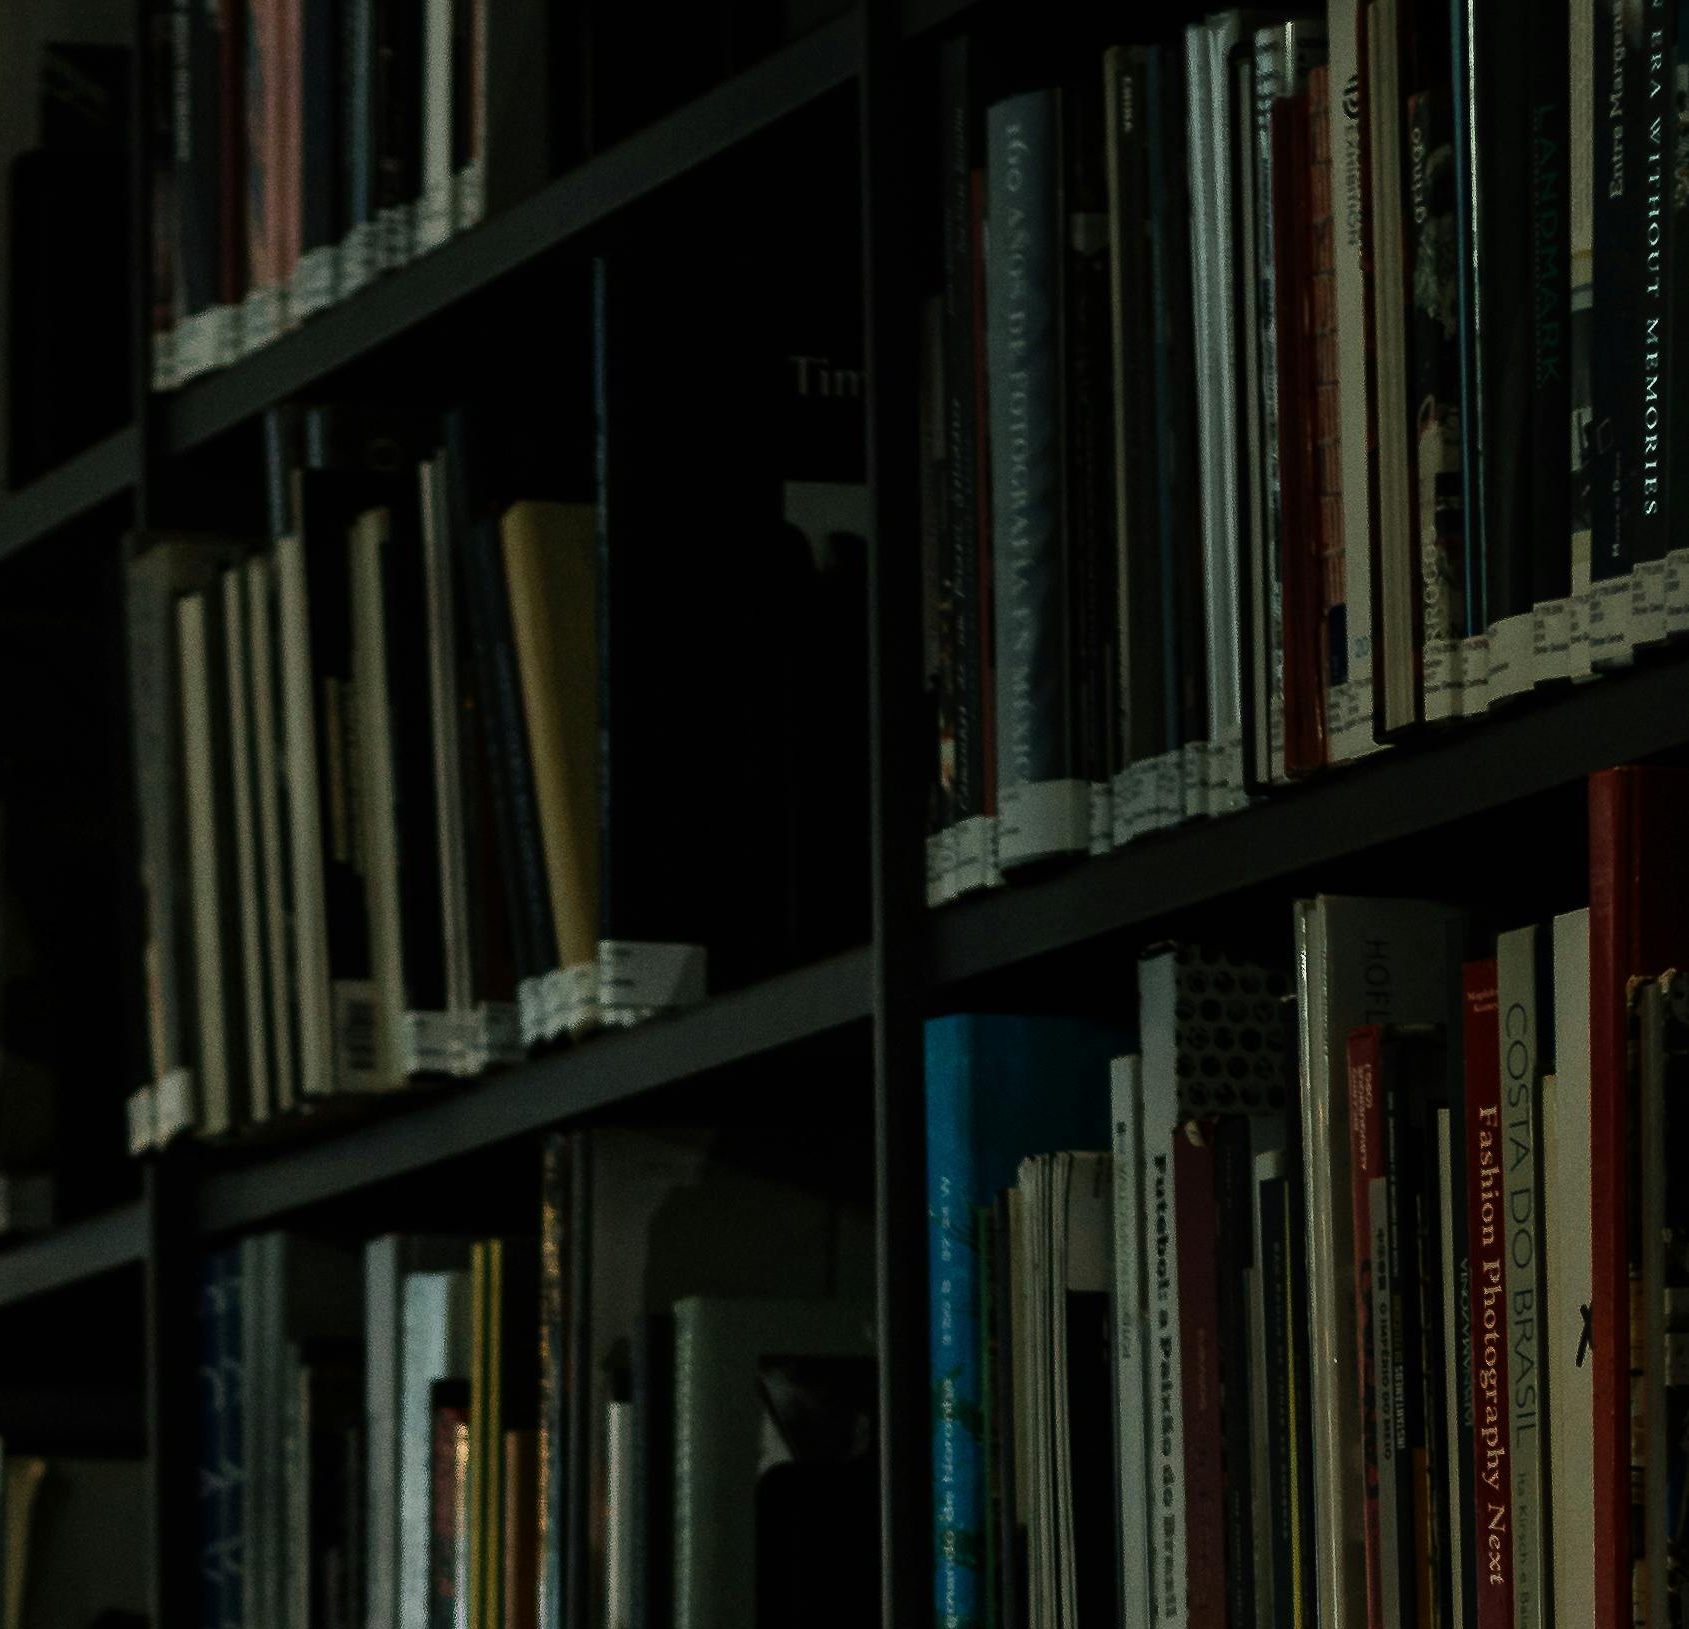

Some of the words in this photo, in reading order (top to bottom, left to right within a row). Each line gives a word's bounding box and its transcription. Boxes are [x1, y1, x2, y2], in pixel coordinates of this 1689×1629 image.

[1648, 29, 1663, 98] ERA
[1411, 128, 1427, 224] gringo
[1608, 125, 1624, 199] Entre
[1645, 116, 1661, 298] WITHOUT
[1540, 103, 1560, 385] LANDMARK
[1643, 318, 1659, 516] MEMORIES
[1011, 667, 1035, 782] MÉXIC
[1506, 1003, 1531, 1171] COSTA
[1479, 1106, 1502, 1246] Fashion
[1510, 1188, 1533, 1269] DO
[1480, 1258, 1505, 1491] Photography
[1513, 1289, 1536, 1449] BRASIL
[1488, 1503, 1506, 1586] Next
[1518, 1505, 1531, 1563] Kirsch
